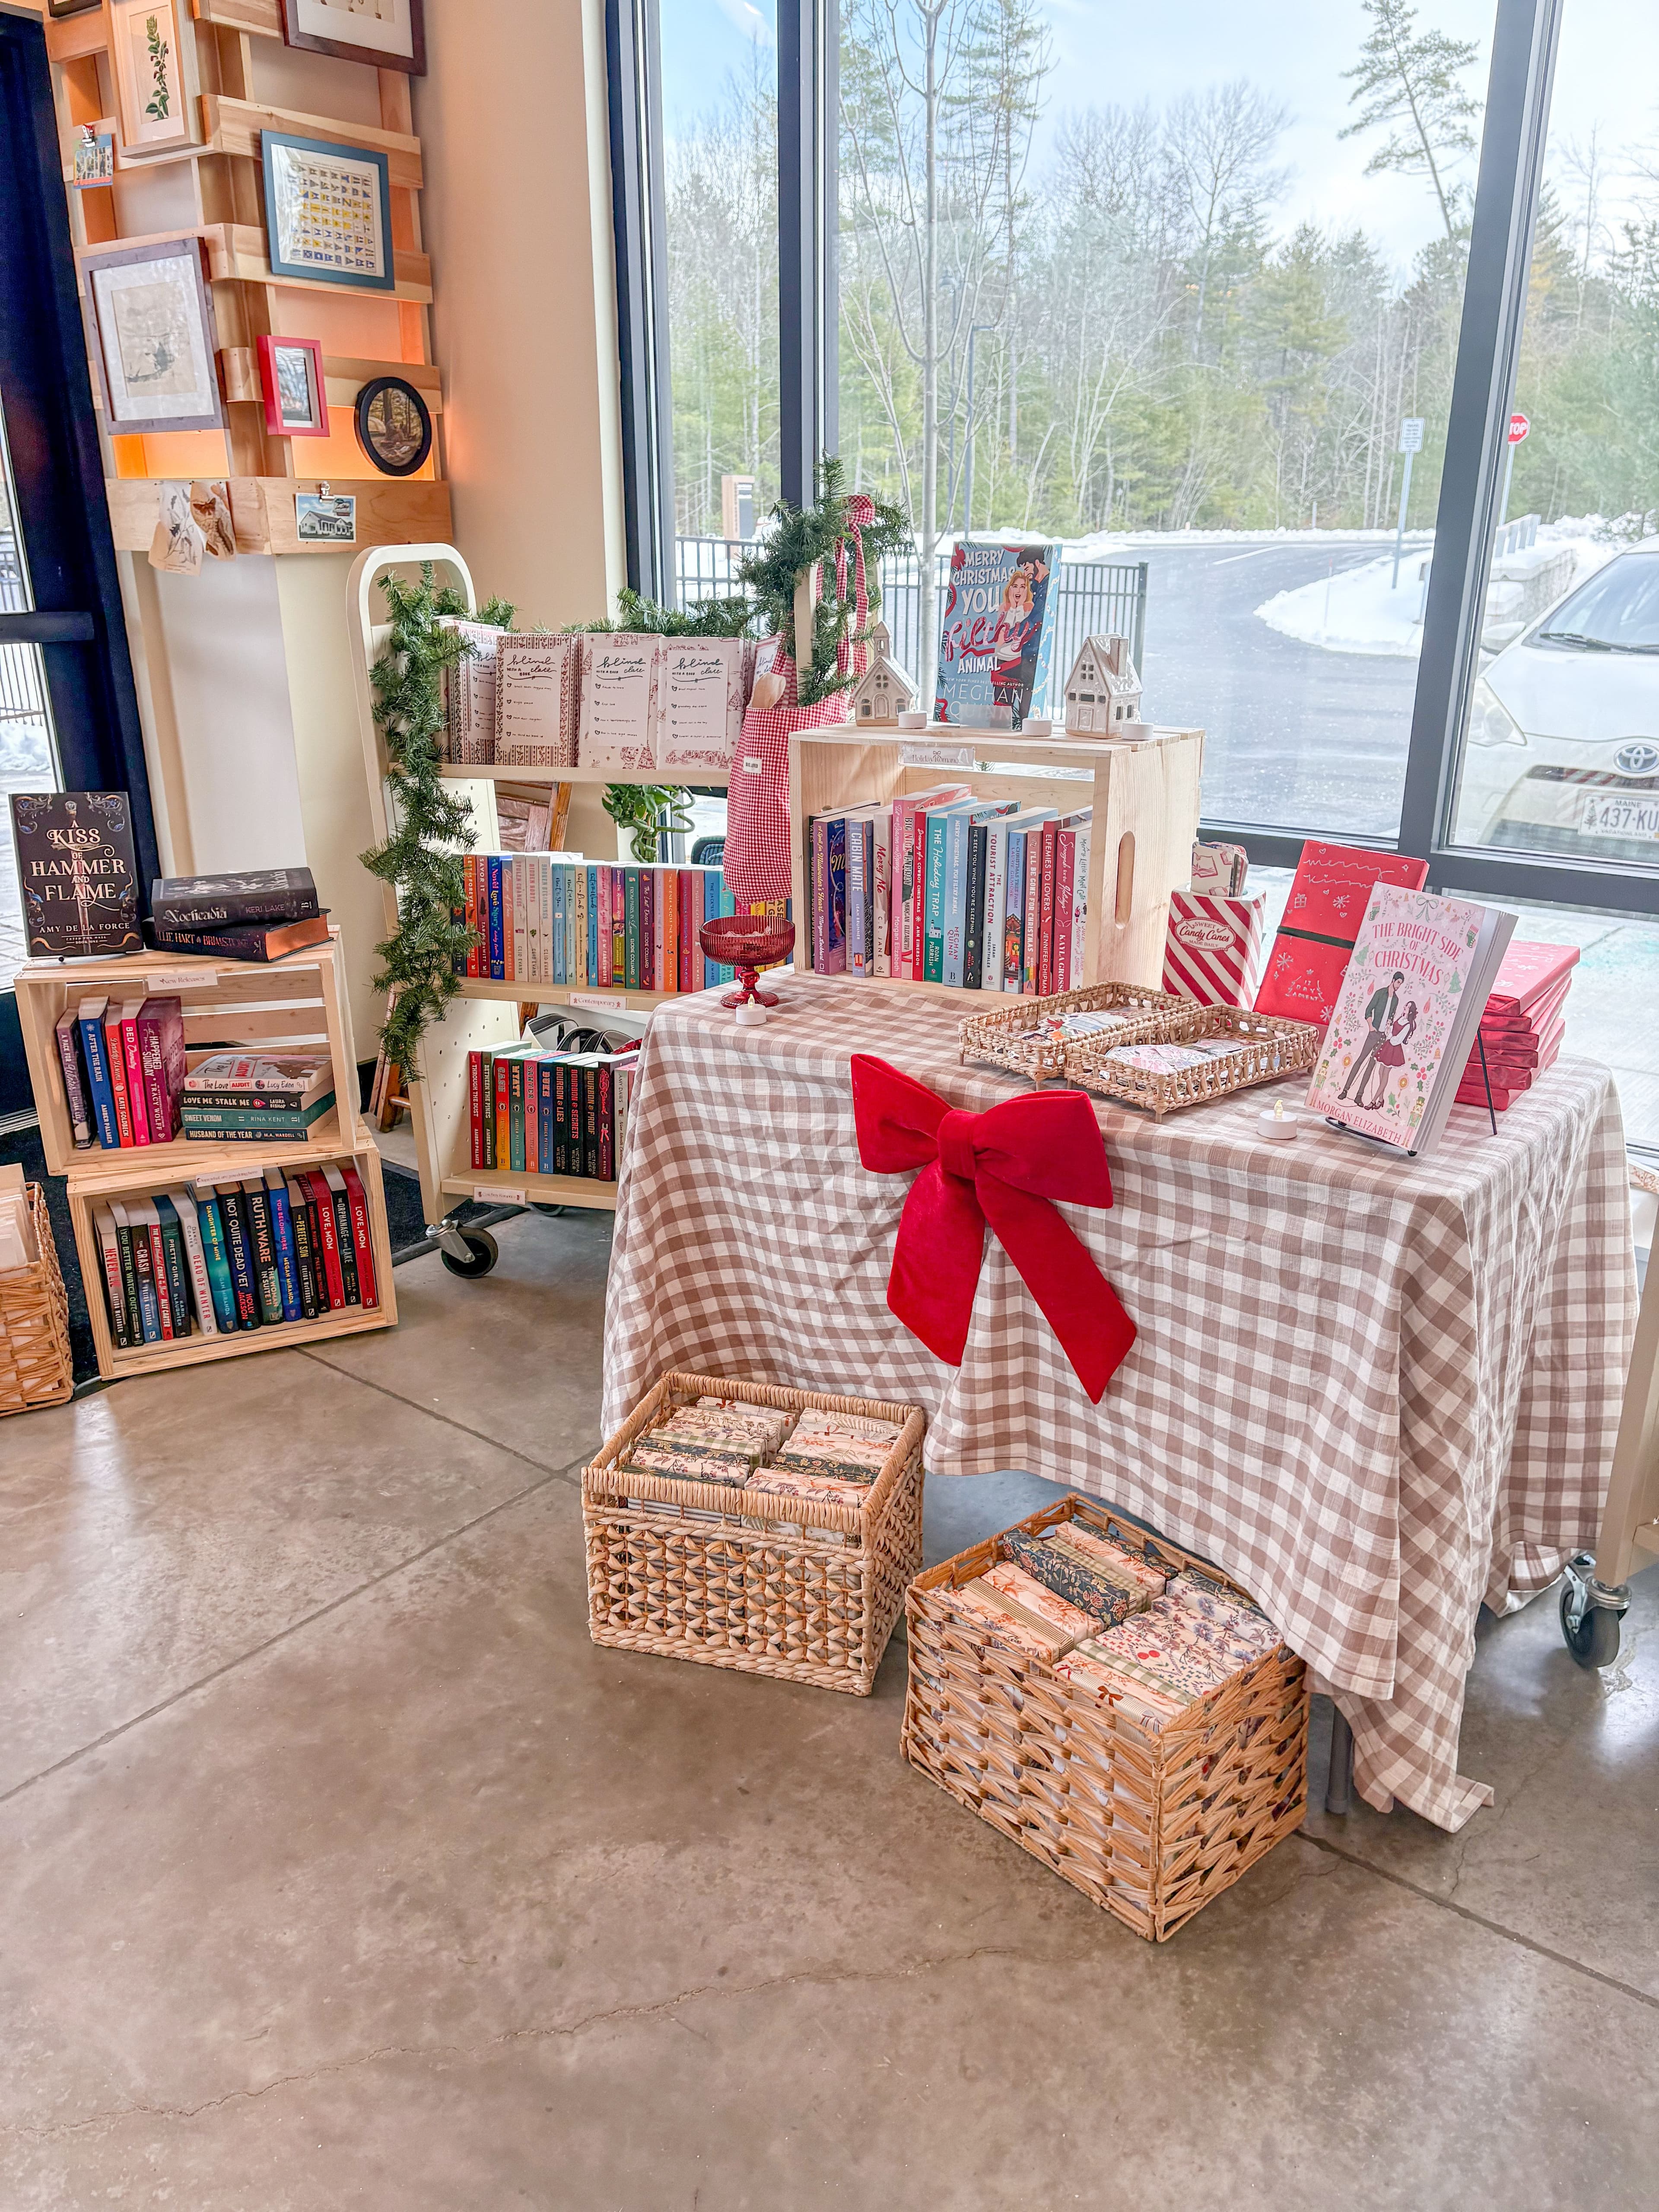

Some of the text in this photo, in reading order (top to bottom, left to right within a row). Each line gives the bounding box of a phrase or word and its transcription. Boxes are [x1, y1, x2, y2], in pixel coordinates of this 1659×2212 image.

[965, 550, 1004, 568] MERRY
[961, 586, 1000, 615] YOU
[944, 612, 1036, 662] filthy
[507, 655, 555, 665] blind
[597, 657, 646, 668] blind
[672, 658, 723, 669] blind
[957, 656, 1001, 674] ANIMAL
[943, 683, 1023, 703] MEGHAN
[912, 755, 932, 763] Holiday
[47, 829, 110, 850] KISS
[30, 859, 126, 876] HAMMER
[851, 832, 863, 892] CABIN MATE
[875, 844, 886, 893] Merry Me
[930, 847, 944, 887] Holiday
[1030, 867, 1036, 876] BE
[71, 875, 90, 884] AND
[1045, 871, 1051, 883] TO
[45, 884, 118, 905] FLAME
[264, 904, 285, 912] LAKE
[1179, 926, 1230, 942] Candy Canes
[1373, 922, 1463, 962] THE BRIGHT SIDE
[1409, 941, 1421, 950] OF
[1375, 950, 1443, 985] CHRISTMAS
[1297, 985, 1315, 993] DAY
[578, 998, 614, 1007] Contemporary
[149, 1036, 162, 1070] HAPPENED
[94, 1065, 103, 1082] RAIN
[143, 1052, 154, 1076] SUNDAY
[202, 1080, 228, 1089] The Love
[1316, 1100, 1402, 1143] MORGAN ELIZABETH
[322, 1207, 331, 1230] LOVE,
[356, 1206, 364, 1229] LOVE,
[252, 1196, 271, 1263] RUTH WARE
[296, 1220, 309, 1258] PERFECT SON
[325, 1231, 334, 1249] MOM
[358, 1230, 366, 1249] MOM
[226, 1198, 248, 1287] NOT QUITE DEAD YET
[137, 1249, 149, 1273] CRASH
[193, 1255, 210, 1319] DEAD OF WINTER
[270, 1281, 279, 1307] WOMAN
[238, 1290, 248, 1320] JACKSON
[245, 1293, 254, 1314] HOLLY
